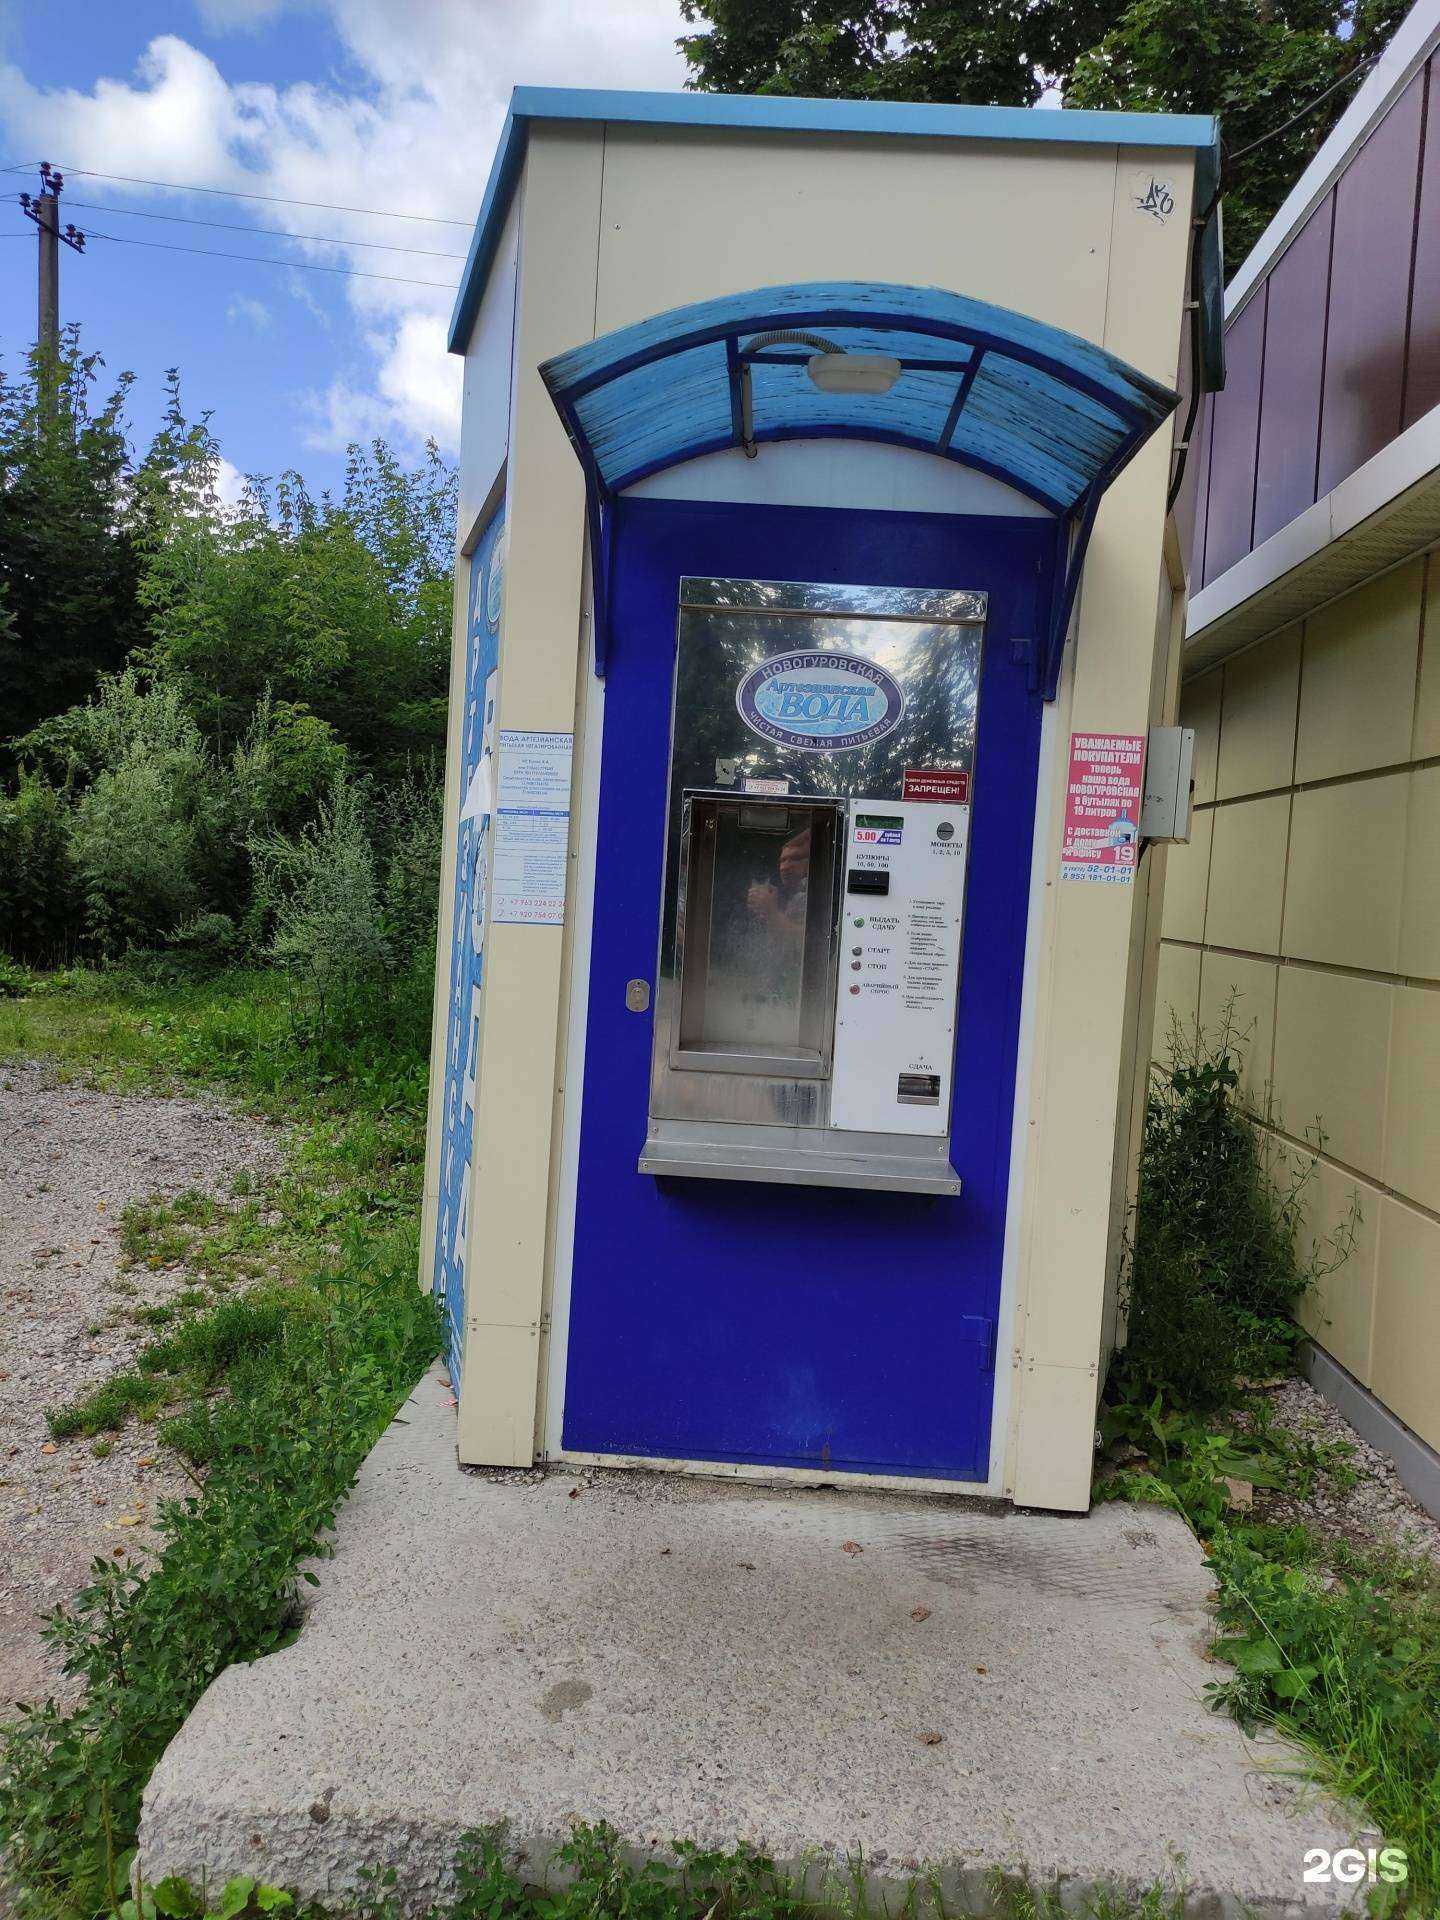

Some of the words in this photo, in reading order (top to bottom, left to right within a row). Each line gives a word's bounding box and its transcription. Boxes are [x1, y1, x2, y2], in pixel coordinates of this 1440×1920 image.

[760, 656, 885, 685] НОВОГУРОВСКАЯ
[778, 692, 870, 724] ВОДА
[750, 711, 784, 739] ЧИСТАЯ
[841, 718, 892, 747] ПИТЬЕВАЯ
[1074, 737, 1142, 752] УВАЖАЕМЫЕ
[1073, 749, 1141, 764] ПОКУПАТЕЛИ
[1090, 764, 1122, 775] теперь
[908, 784, 960, 795] ЗАПРЕЩЕН!
[856, 831, 876, 841] 5.00
[1113, 846, 1135, 860] 19
[1087, 865, 1133, 874] 52-01-01
